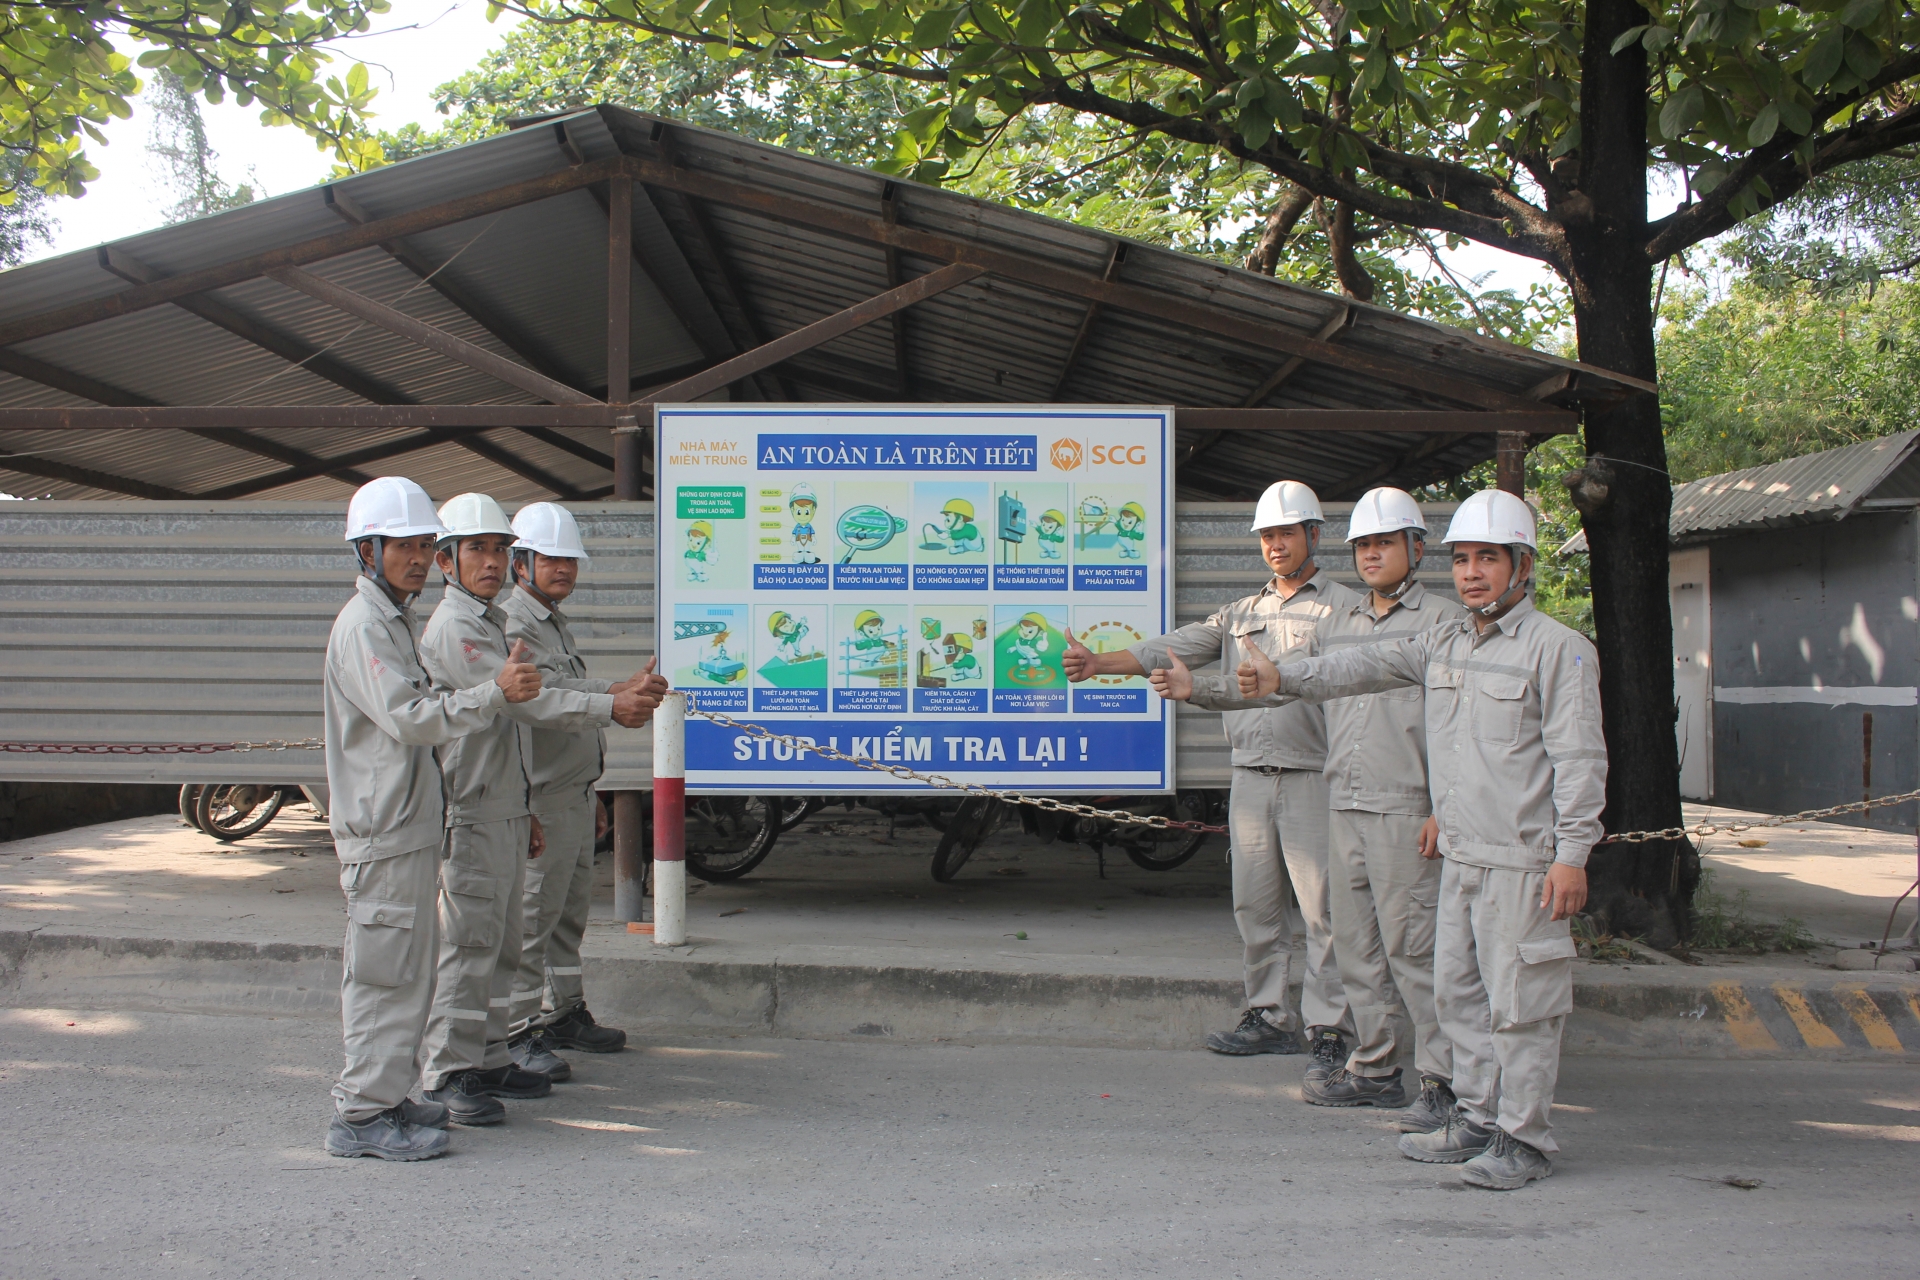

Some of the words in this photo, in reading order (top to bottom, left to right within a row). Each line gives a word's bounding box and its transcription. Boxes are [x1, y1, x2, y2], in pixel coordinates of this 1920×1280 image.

[680, 439, 706, 451] NHÀ
[710, 439, 737, 451] MÁY
[761, 446, 796, 464] AN
[801, 441, 868, 465] TOÀN
[874, 441, 906, 465] LÀ
[911, 441, 978, 465] TRÊN
[984, 440, 1034, 466] HẾT
[1092, 445, 1147, 465] SCG
[704, 455, 748, 466] TRUNG
[788, 567, 795, 575] BỊ
[776, 577, 787, 585] HỘ
[805, 577, 827, 585] ĐỘNG
[890, 576, 906, 585] VIỆC
[734, 736, 816, 761] STOP
[852, 726, 932, 761] KIỂM
[944, 737, 1006, 761] TRA
[1018, 737, 1065, 767] LẠI
[1080, 737, 1088, 761] !
